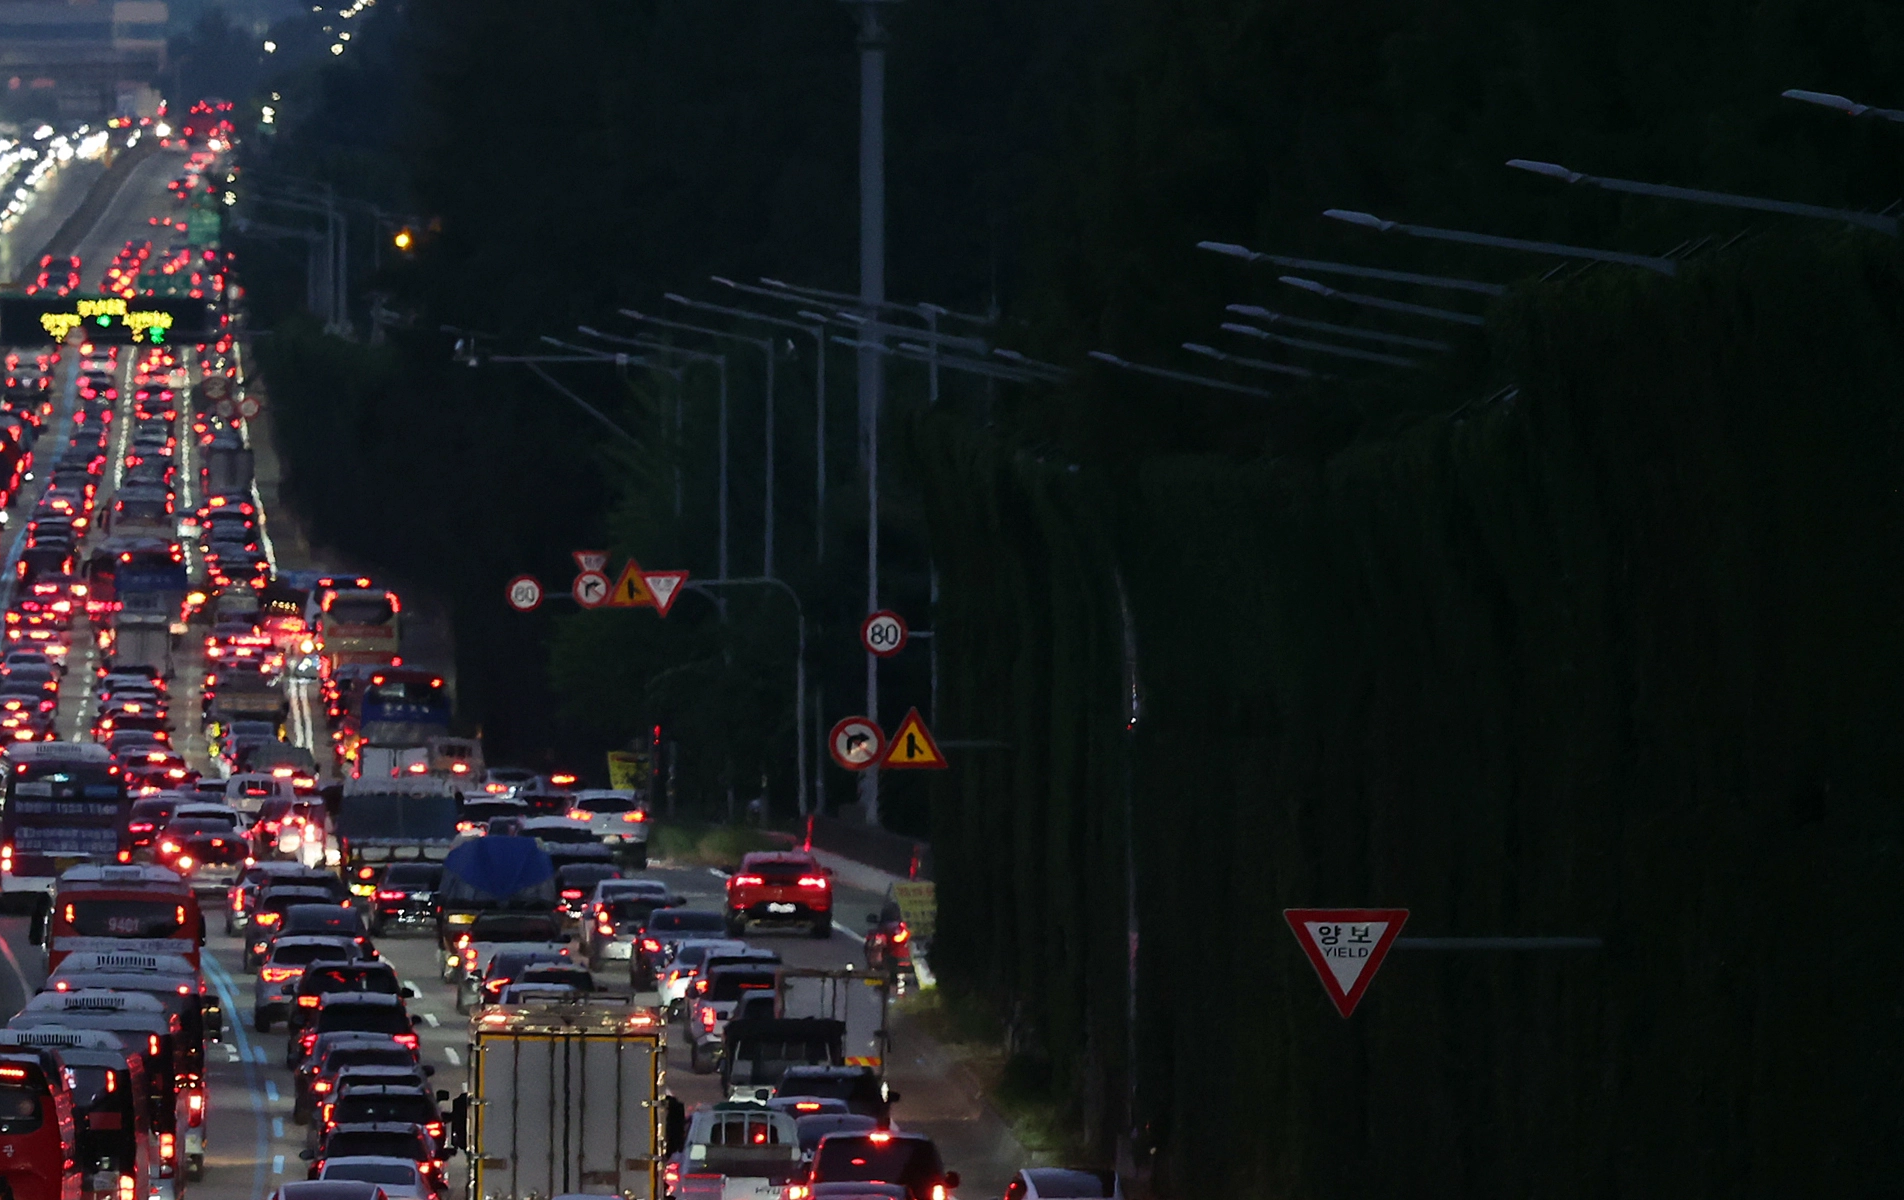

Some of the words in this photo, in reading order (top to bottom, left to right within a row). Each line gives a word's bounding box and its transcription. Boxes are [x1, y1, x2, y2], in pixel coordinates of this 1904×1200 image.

[513, 586, 535, 602] 80
[871, 624, 898, 646] 80
[1318, 925, 1373, 945] 양보
[1323, 947, 1369, 958] YIELD
